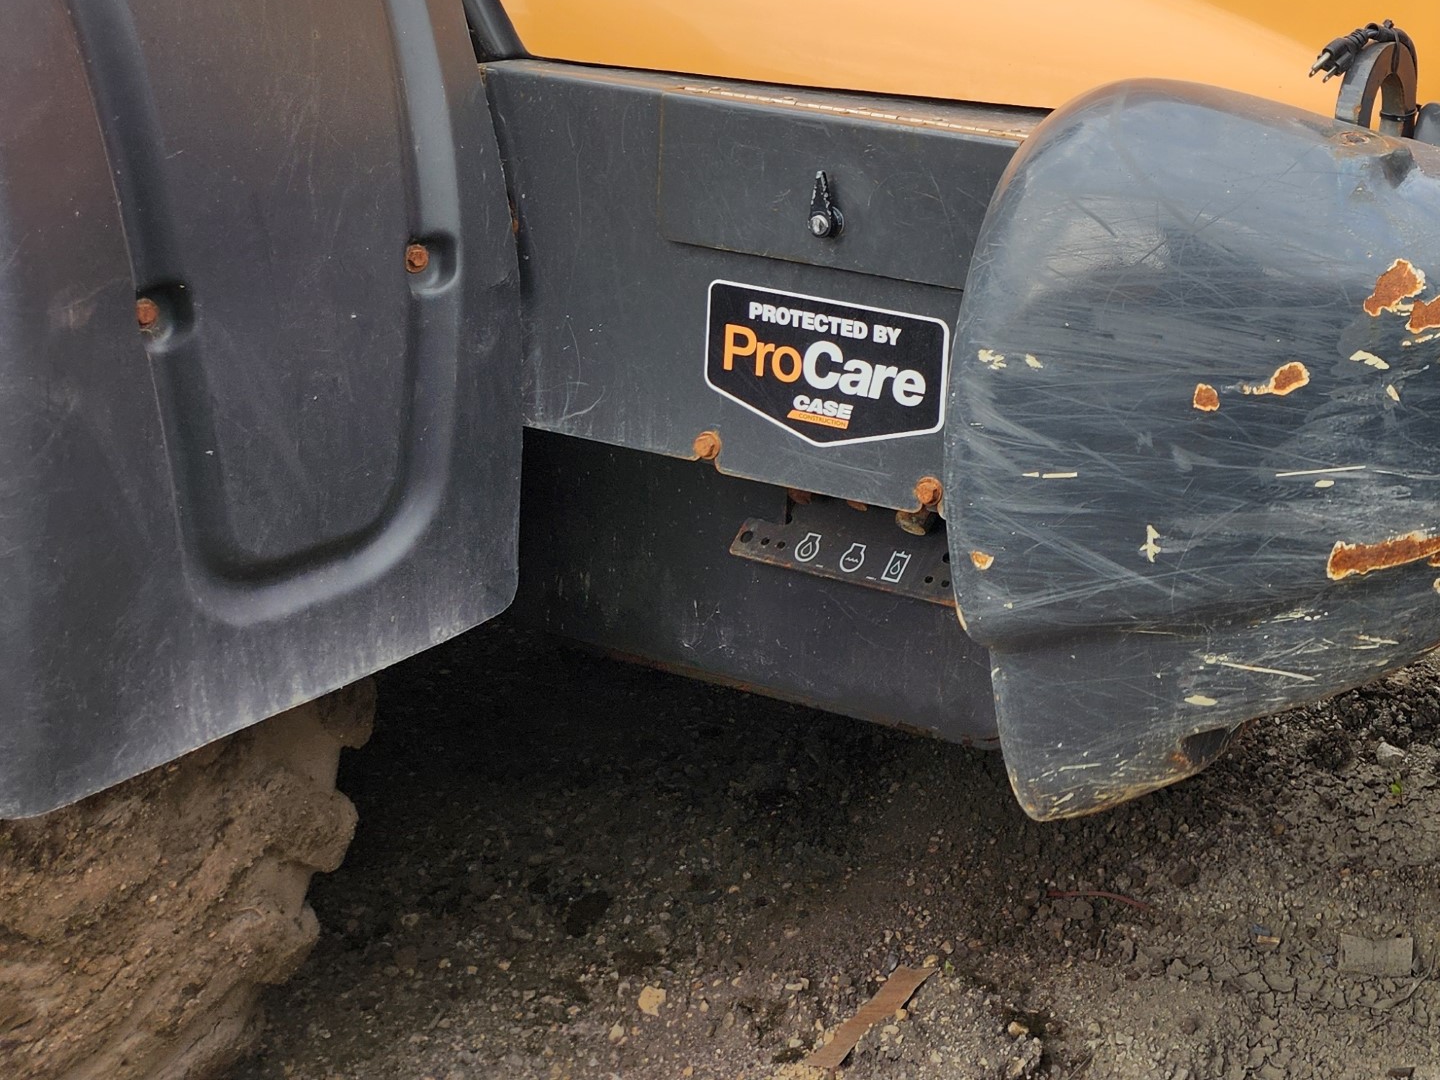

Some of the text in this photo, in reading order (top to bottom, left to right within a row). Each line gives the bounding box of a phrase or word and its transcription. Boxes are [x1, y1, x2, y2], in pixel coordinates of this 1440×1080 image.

[749, 302, 902, 346] PROTECTED BY
[723, 323, 926, 407] ProCare
[793, 395, 854, 420] CASE
[798, 412, 847, 427] CONSTRUCTION
